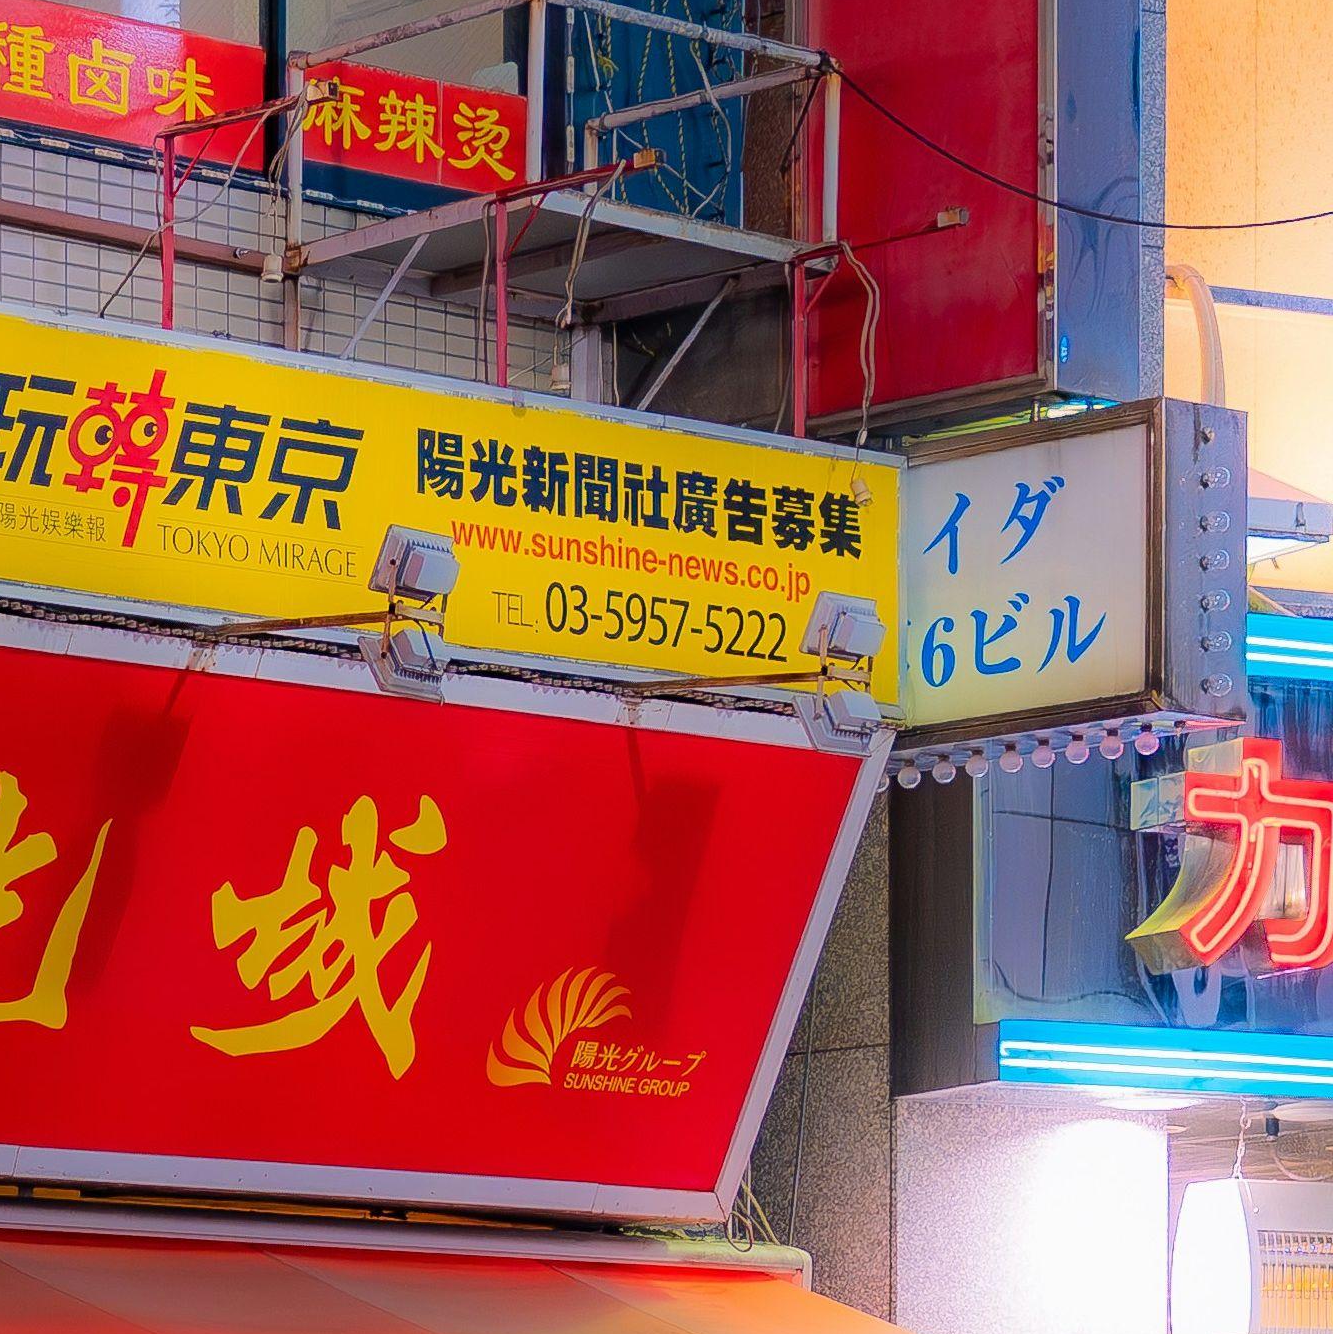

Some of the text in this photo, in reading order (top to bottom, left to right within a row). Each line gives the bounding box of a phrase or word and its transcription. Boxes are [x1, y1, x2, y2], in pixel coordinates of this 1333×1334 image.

[301, 76, 518, 182] 麻辣烫
[416, 427, 862, 560] 陽光新聞社廣告募集
[921, 474, 1065, 576] イダ
[157, 521, 358, 579] TOKYO MIRAGE
[450, 517, 811, 603] www.sunshine-news.co.jp
[545, 580, 789, 664] 03-5957-5222
[563, 1071, 691, 1098] SUNSHINE GROUP
[570, 1039, 708, 1077] 陽光グループ
